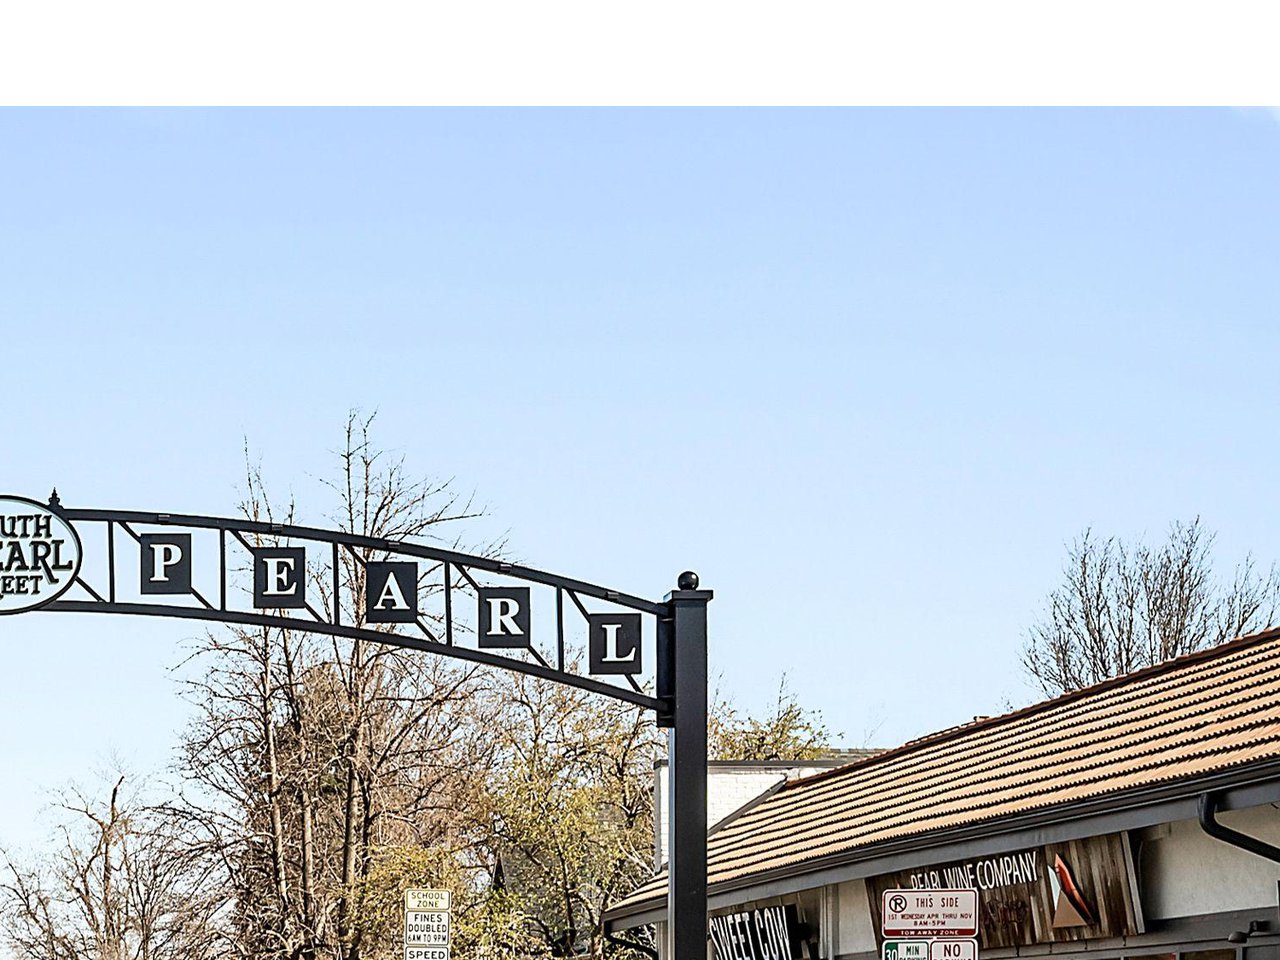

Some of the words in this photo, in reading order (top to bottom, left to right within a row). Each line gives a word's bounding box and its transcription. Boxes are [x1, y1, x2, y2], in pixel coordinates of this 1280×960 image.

[943, 864, 975, 889] WINE
[976, 851, 1040, 891] COMPANY
[411, 892, 445, 900] SCHOOL
[416, 900, 439, 908] ZONE
[916, 897, 934, 908] THIS
[940, 897, 959, 908] SIDE
[414, 914, 442, 923] FINES
[409, 923, 447, 933] DOUBLED
[408, 934, 422, 943] 6AM
[423, 934, 431, 942] TO
[433, 934, 447, 943] 9PM
[409, 951, 446, 959] SPEED
[905, 946, 920, 956] MIN
[943, 944, 961, 957] NO
